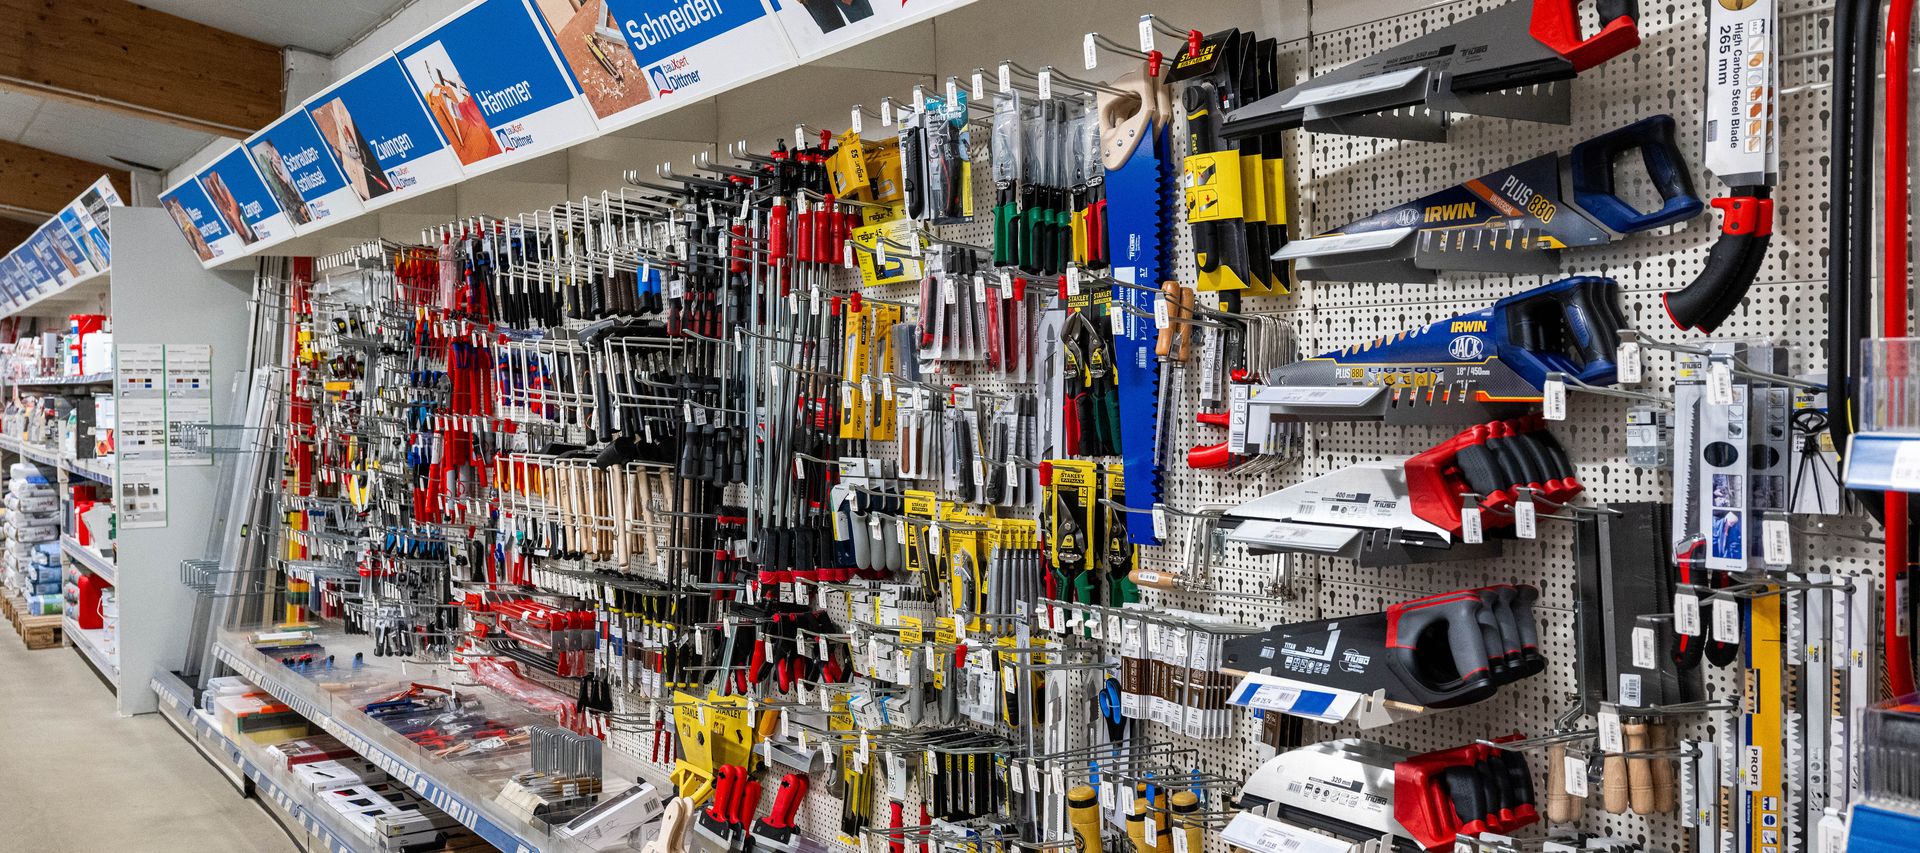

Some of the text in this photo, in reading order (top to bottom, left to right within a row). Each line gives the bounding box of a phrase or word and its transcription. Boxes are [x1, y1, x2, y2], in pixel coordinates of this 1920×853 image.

[625, 0, 723, 51] Schneiden
[662, 55, 690, 73] bauXpert
[1180, 44, 1217, 62] STLEY
[1718, 25, 1732, 85] 265 mm
[668, 69, 701, 91] Dittmer
[1730, 22, 1744, 149] High Carbon Steel Blade
[476, 79, 533, 117] Hämmer
[370, 132, 415, 161] Zwingen
[510, 133, 534, 149] Dittmer
[283, 146, 319, 173] Schrauben-
[851, 149, 859, 159] 53
[297, 166, 327, 194] schlüssel
[239, 199, 264, 218] Zangen
[1489, 193, 1515, 217] UNIVERSAL
[1501, 174, 1557, 225] PLUS 880
[1397, 210, 1418, 224] JACK
[1424, 201, 1477, 223] IRWIN
[1139, 267, 1145, 278] 17
[1451, 320, 1487, 333] IRWIN
[1452, 336, 1480, 359] JACK
[1335, 368, 1350, 379] PLUS
[1351, 367, 1364, 378] 880
[682, 705, 699, 720] STANLE
[1331, 776, 1342, 784] 320
